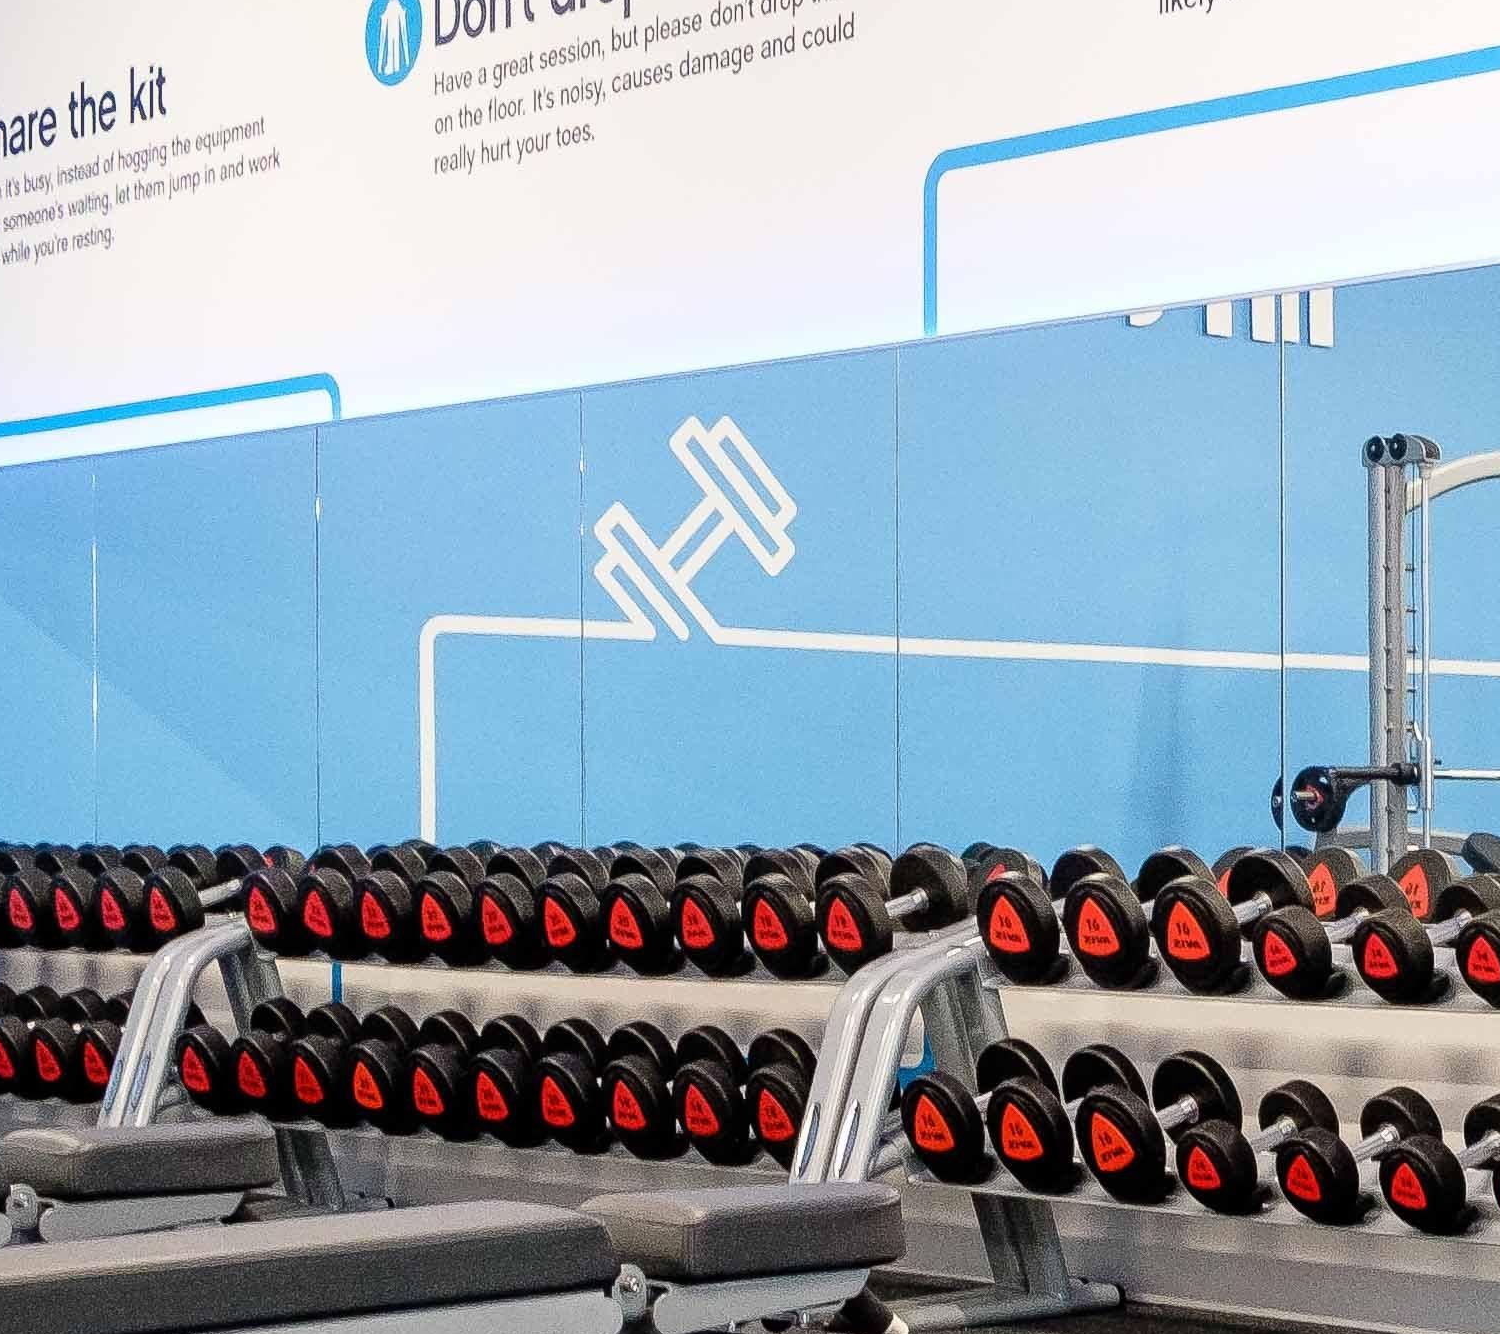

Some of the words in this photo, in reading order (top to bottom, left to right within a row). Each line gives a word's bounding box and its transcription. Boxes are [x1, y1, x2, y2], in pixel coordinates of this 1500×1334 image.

[435, 71, 472, 95] Have
[478, 67, 486, 85] a
[493, 51, 534, 89] great
[540, 37, 604, 69] session,
[612, 25, 638, 51] but
[645, 14, 702, 52] please
[435, 115, 452, 134] on
[459, 104, 482, 129] the
[489, 97, 525, 123] floor.
[534, 87, 554, 112] It's
[561, 78, 605, 106] noisy,
[612, 63, 672, 93] causes
[680, 44, 754, 78] damage
[761, 26, 795, 59] and
[803, 11, 854, 50] could
[69, 81, 116, 139] the
[130, 66, 166, 123] kit
[3, 202, 63, 232] someone's
[68, 195, 111, 216] waiting,
[116, 184, 129, 204] let
[134, 180, 164, 200] them
[169, 171, 200, 199] jump
[205, 168, 215, 183] in
[221, 155, 243, 181] and
[249, 147, 280, 174] work
[6, 178, 20, 197] it's
[24, 173, 53, 195] busy,
[57, 155, 99, 185] instead
[104, 152, 114, 173] of
[118, 145, 167, 173] hogging
[172, 136, 190, 156] the
[196, 117, 264, 154] equipment
[435, 144, 475, 175] really
[482, 138, 511, 163] hurt
[517, 133, 551, 164] your
[556, 124, 594, 147] toes.
[2, 241, 30, 264] while
[34, 236, 68, 264] you're
[73, 228, 114, 251] resting.
